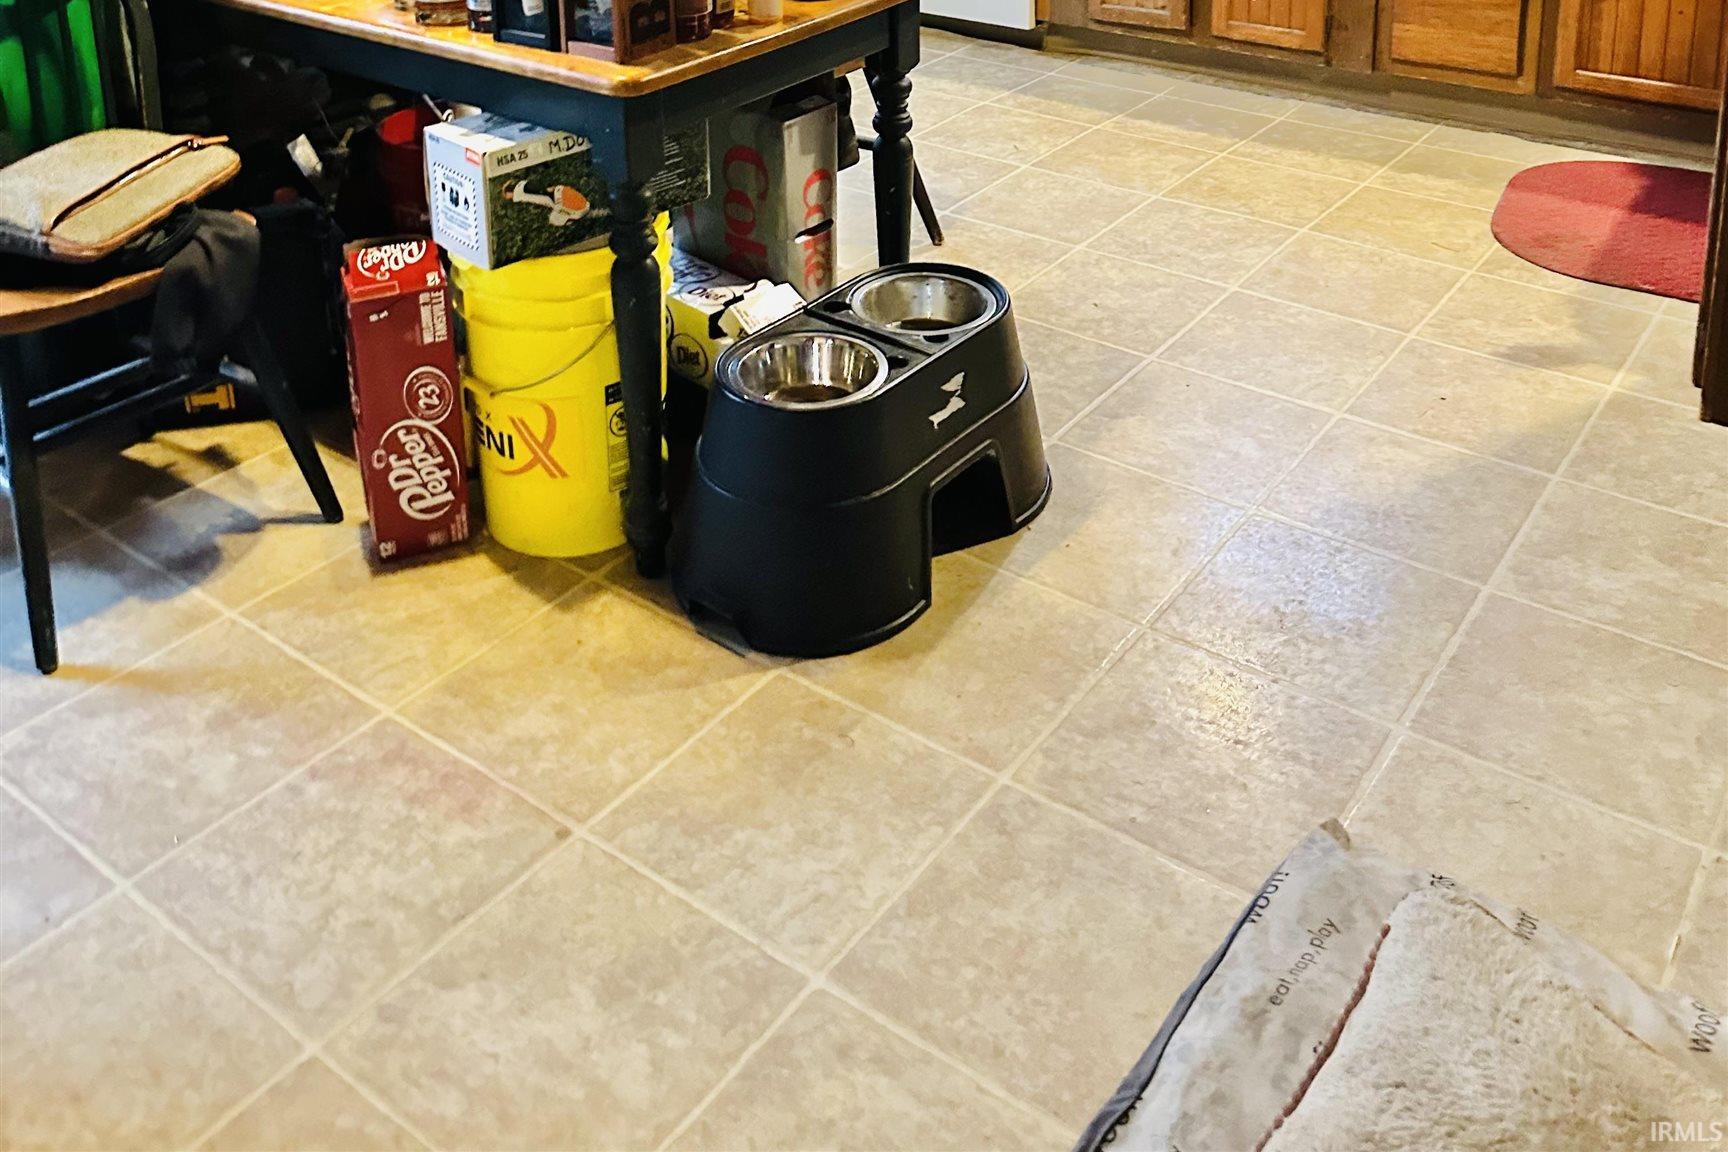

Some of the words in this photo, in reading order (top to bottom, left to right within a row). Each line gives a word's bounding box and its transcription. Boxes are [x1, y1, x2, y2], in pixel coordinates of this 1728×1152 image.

[496, 153, 517, 167] HSA
[517, 149, 529, 162] 25
[417, 383, 440, 409] 23
[387, 452, 422, 492] Dr
[398, 427, 456, 516] Pepper
